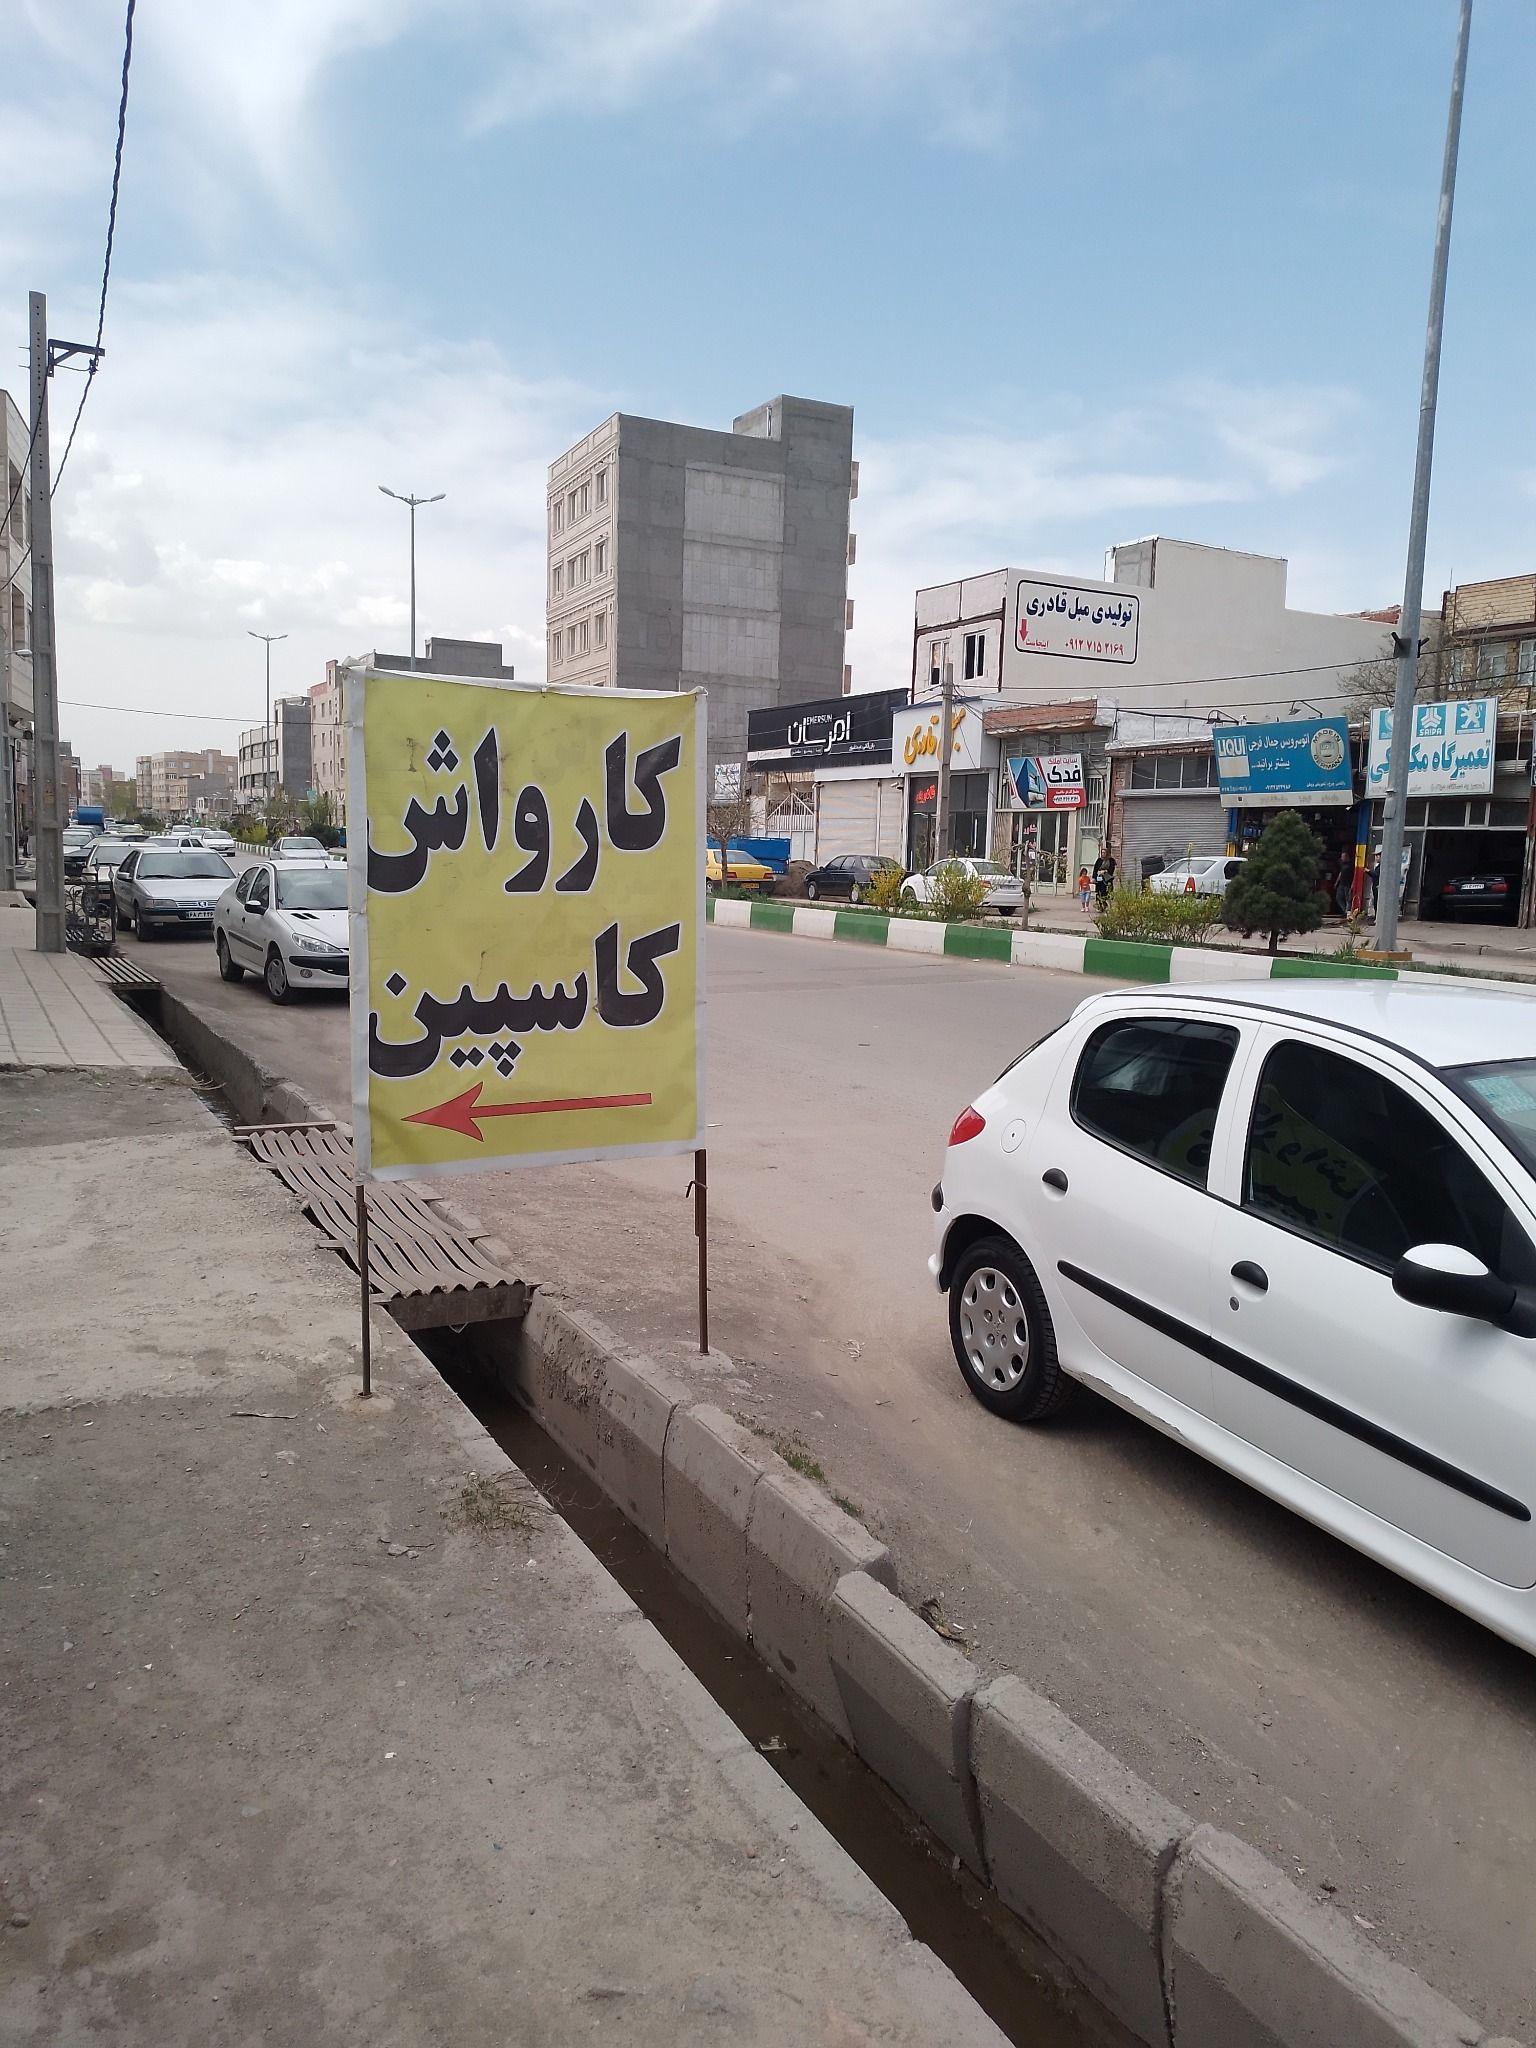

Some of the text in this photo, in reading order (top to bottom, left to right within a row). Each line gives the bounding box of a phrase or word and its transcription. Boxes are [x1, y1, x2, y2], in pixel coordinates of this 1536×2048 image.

[1026, 592, 1133, 627] تولیدی مبل قادری
[1217, 738, 1246, 757] LIQUI
[1419, 728, 1442, 736] SAIPA
[1432, 739, 1491, 781] تعمیرگاه
[366, 726, 682, 894] کارواش
[367, 922, 681, 1078] کاسپین
